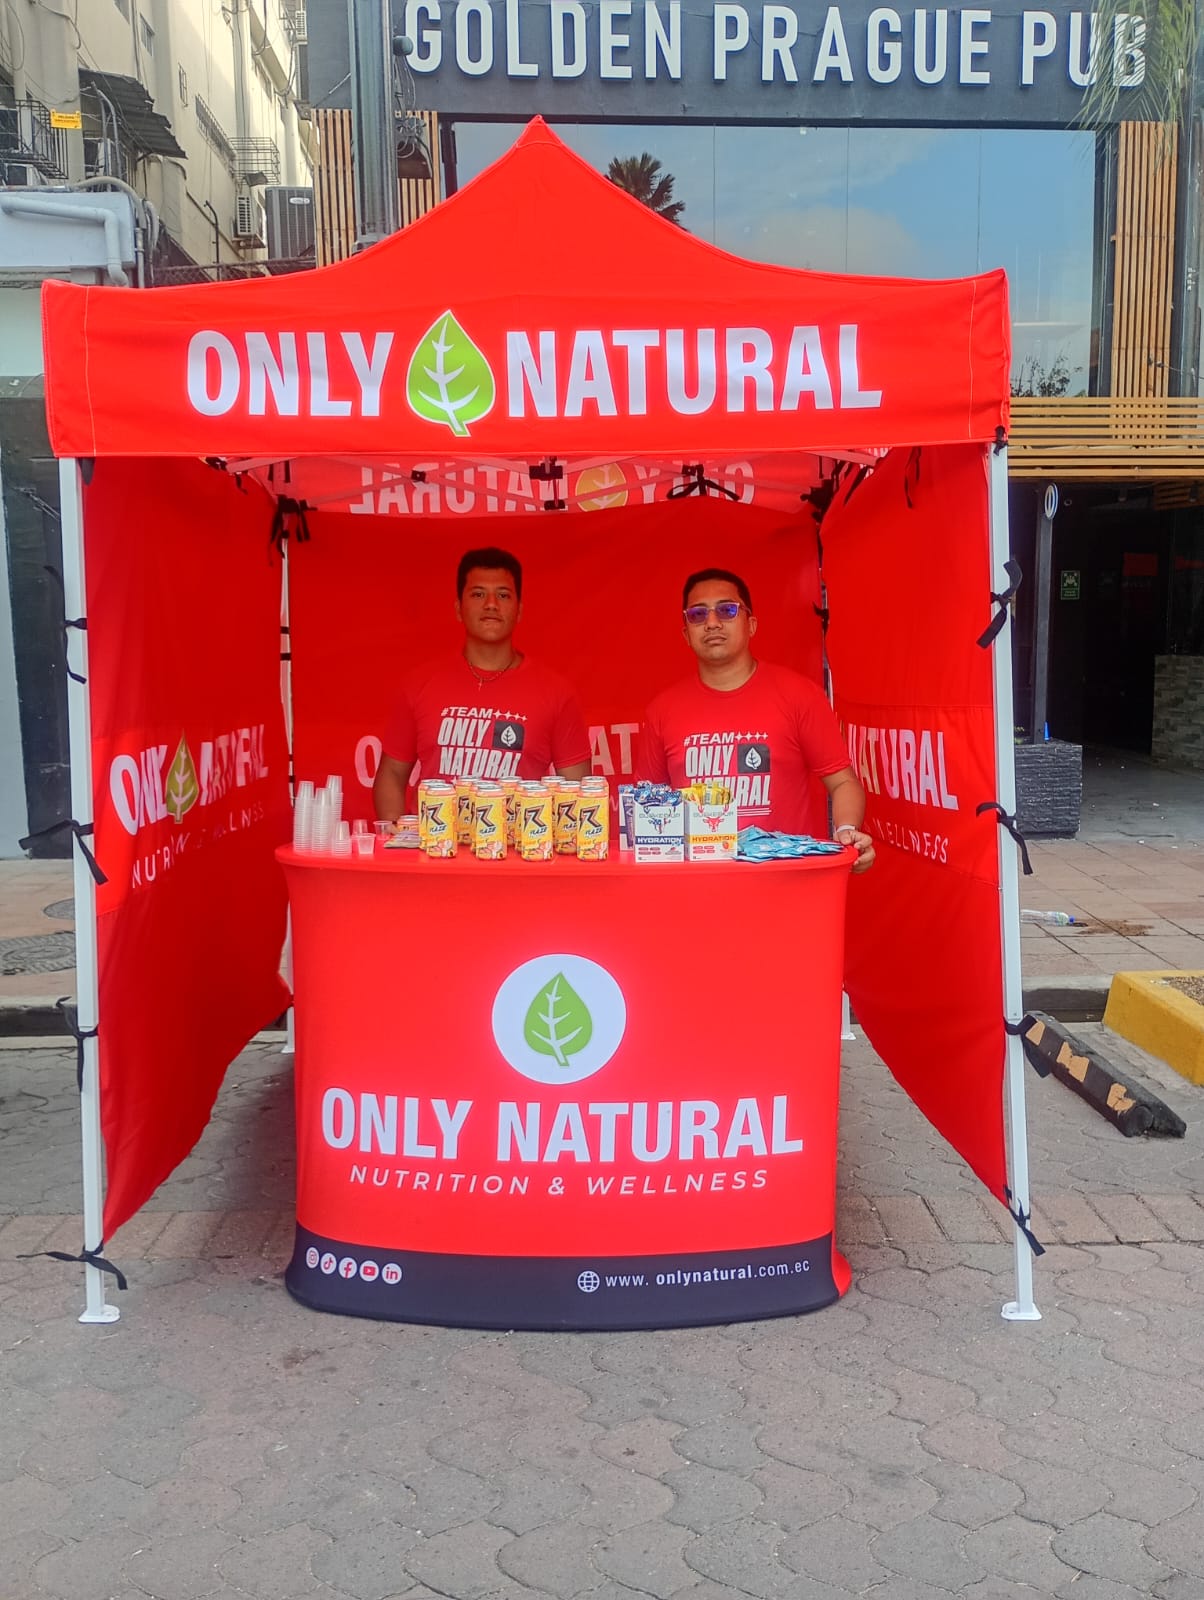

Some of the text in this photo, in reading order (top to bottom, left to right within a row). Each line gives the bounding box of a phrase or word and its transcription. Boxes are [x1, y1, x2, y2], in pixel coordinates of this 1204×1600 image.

[405, 0, 1146, 86] GOLDEN PRAGUE PUB
[187, 324, 883, 418] ONLY NATURAL
[441, 706, 493, 719] #TEAM
[437, 717, 491, 747] ONLY
[683, 732, 735, 746] #TEAM
[439, 746, 522, 779] NATURAL
[685, 745, 735, 777] ONLY
[322, 1087, 803, 1163] ONLY NATURAL
[350, 1165, 768, 1195] NUTRITION & WELLNESS
[605, 1259, 810, 1287] www. onlynatural.com.ec
